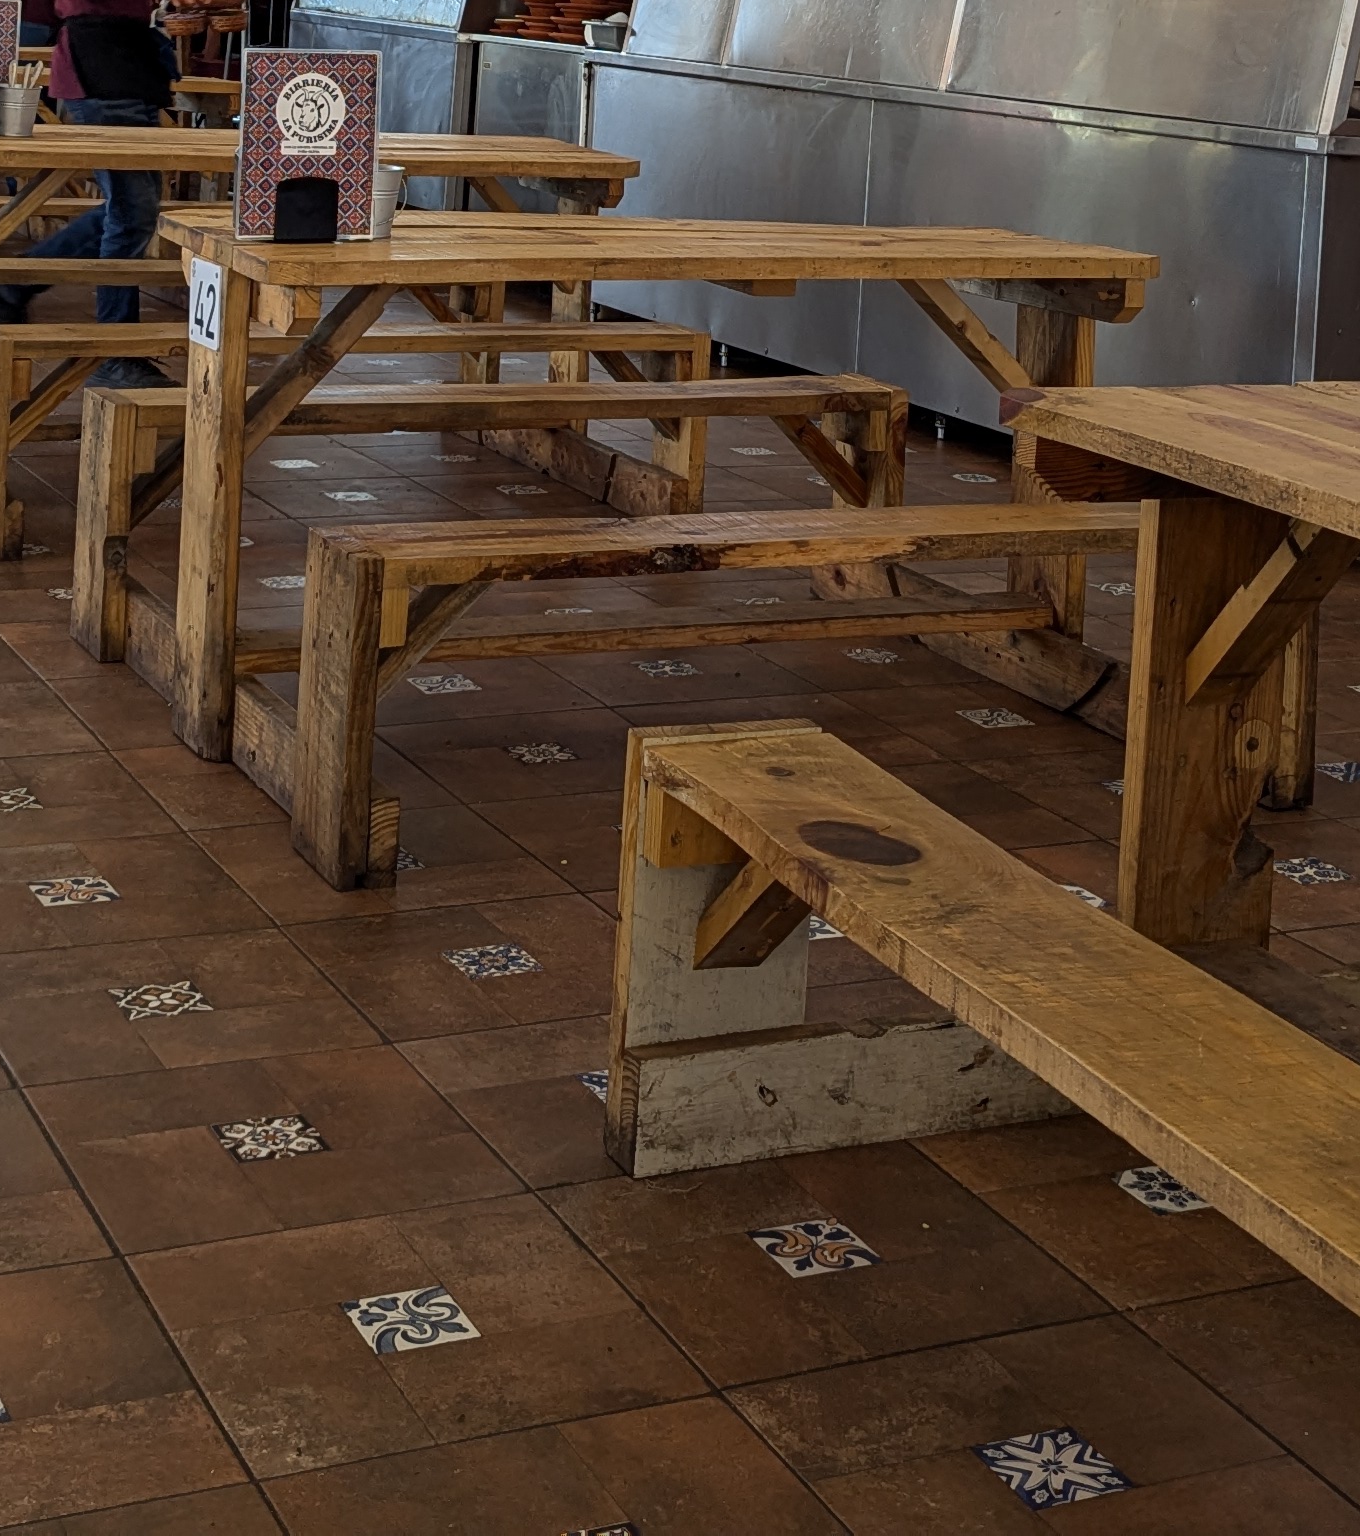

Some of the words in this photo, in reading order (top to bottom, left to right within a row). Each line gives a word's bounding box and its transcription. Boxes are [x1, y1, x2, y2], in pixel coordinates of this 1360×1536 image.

[282, 78, 339, 103] BIRRIERÍA
[282, 118, 293, 133] LA
[290, 119, 339, 144] PURISIMA
[194, 280, 217, 341] 42
